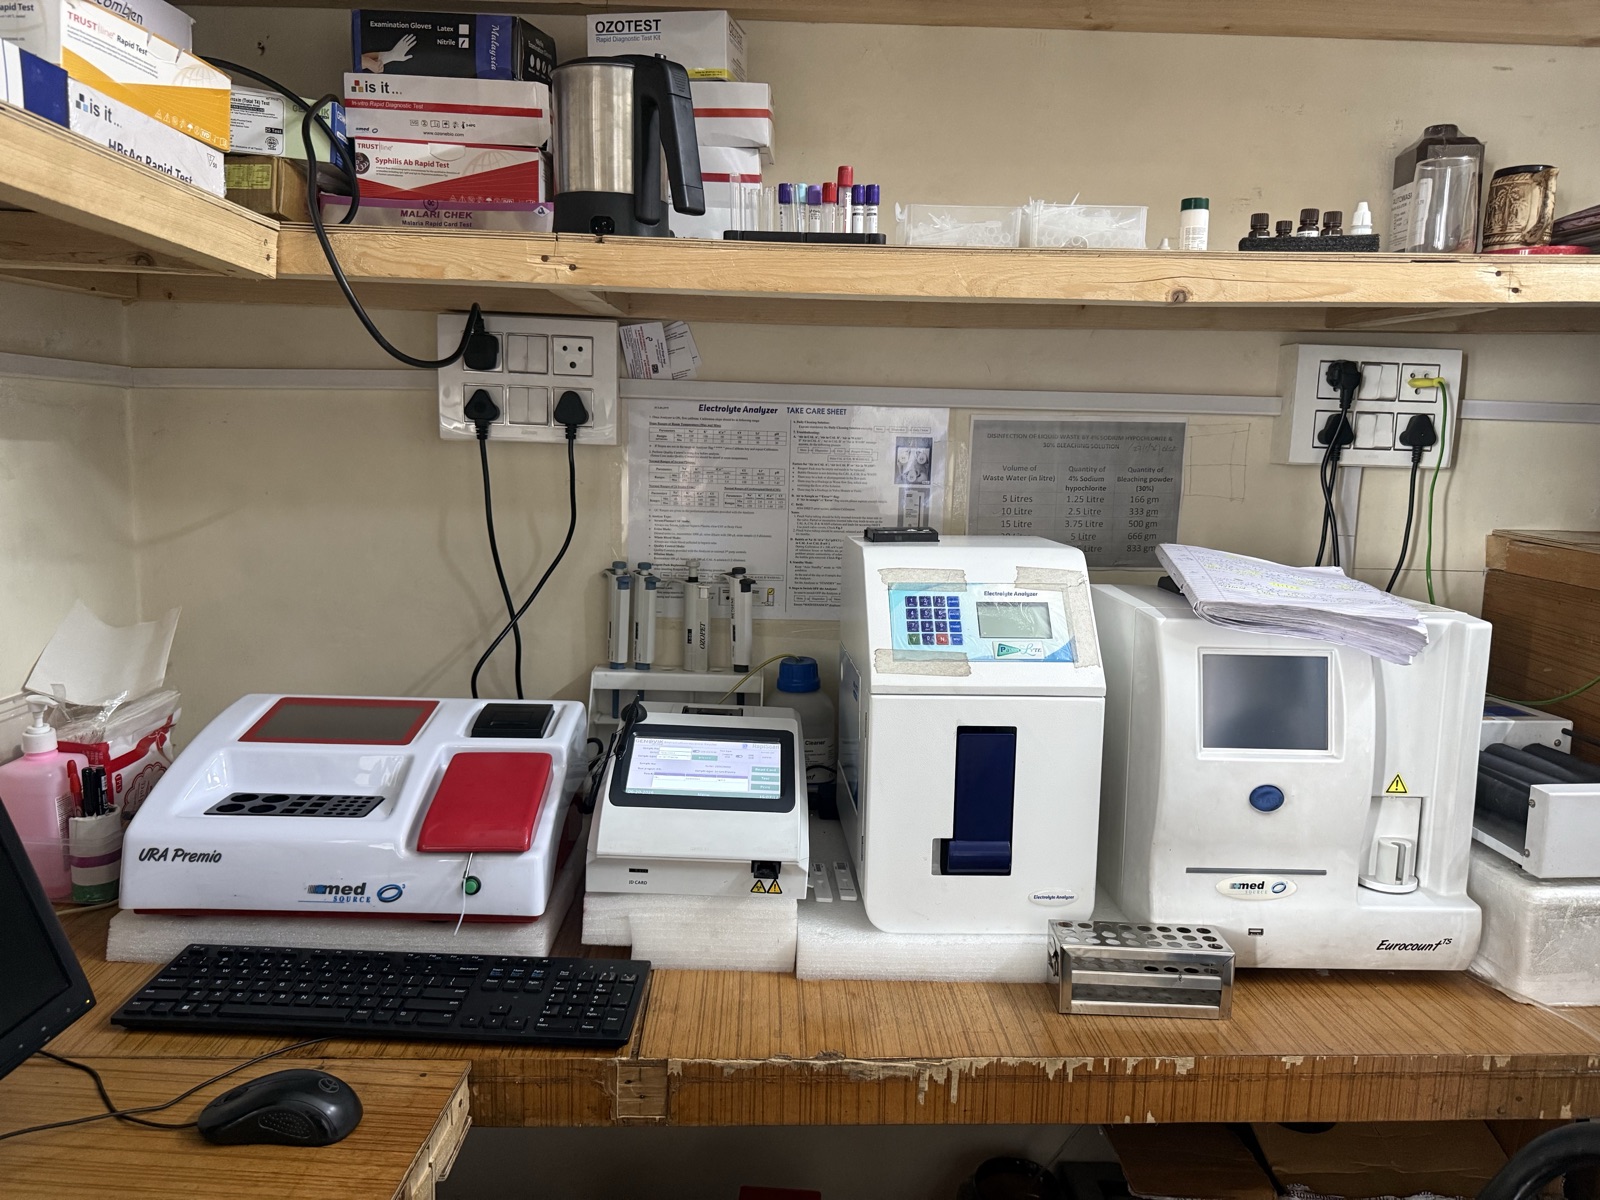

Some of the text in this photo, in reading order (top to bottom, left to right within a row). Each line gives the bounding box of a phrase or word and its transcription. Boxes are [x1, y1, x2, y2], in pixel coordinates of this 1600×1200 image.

[0, 3, 16, 12] apid
[369, 20, 432, 30] Examination Gloves
[595, 19, 662, 33] OZOTEST
[437, 38, 456, 46] Nitrile
[595, 35, 612, 43] Rapid
[612, 35, 640, 43] Diagnostic
[116, 35, 148, 56] Rapid Test
[489, 24, 500, 71] Malaysia
[364, 80, 377, 93] is
[89, 98, 100, 117] is
[385, 102, 412, 110] Diagnostic
[375, 156, 450, 169] Syphilis Ab Rapid Test
[400, 209, 473, 220] MALARI CHEK
[401, 219, 424, 227] Malaria
[424, 220, 442, 228] Rapid
[698, 403, 847, 416] Electrolyte Analyzer TAKE CARE SHEET
[1068, 466, 1098, 474] Quantity
[1127, 466, 1156, 475] Quantity
[1005, 474, 1027, 482] Water
[1028, 474, 1038, 482] (in
[1038, 474, 1056, 483] litre)
[1116, 476, 1174, 484] Bleaching powder
[1065, 485, 1107, 493] hypochlorite
[1135, 485, 1155, 493] (30%)
[1002, 495, 1033, 503] 5 Litres
[1066, 495, 1105, 503] 1.25 Litre
[1130, 496, 1160, 505] 166 gm
[1001, 507, 1033, 515] 10 Litre
[1067, 508, 1102, 516] 2.5 Litre
[1129, 508, 1159, 517] 333 gm
[1000, 519, 1033, 528] 15 Litre
[1065, 520, 1104, 528] 3.75 Litre
[1128, 520, 1158, 530] 500 gm
[1070, 532, 1097, 541] 5 Litre
[1127, 532, 1157, 542] 666 gm
[1084, 544, 1103, 553] Litre
[1126, 544, 1156, 554] 833 gm
[138, 847, 222, 863] URA Premio
[333, 895, 371, 903] SOURCE
[1376, 937, 1453, 951] Eurocount TS
